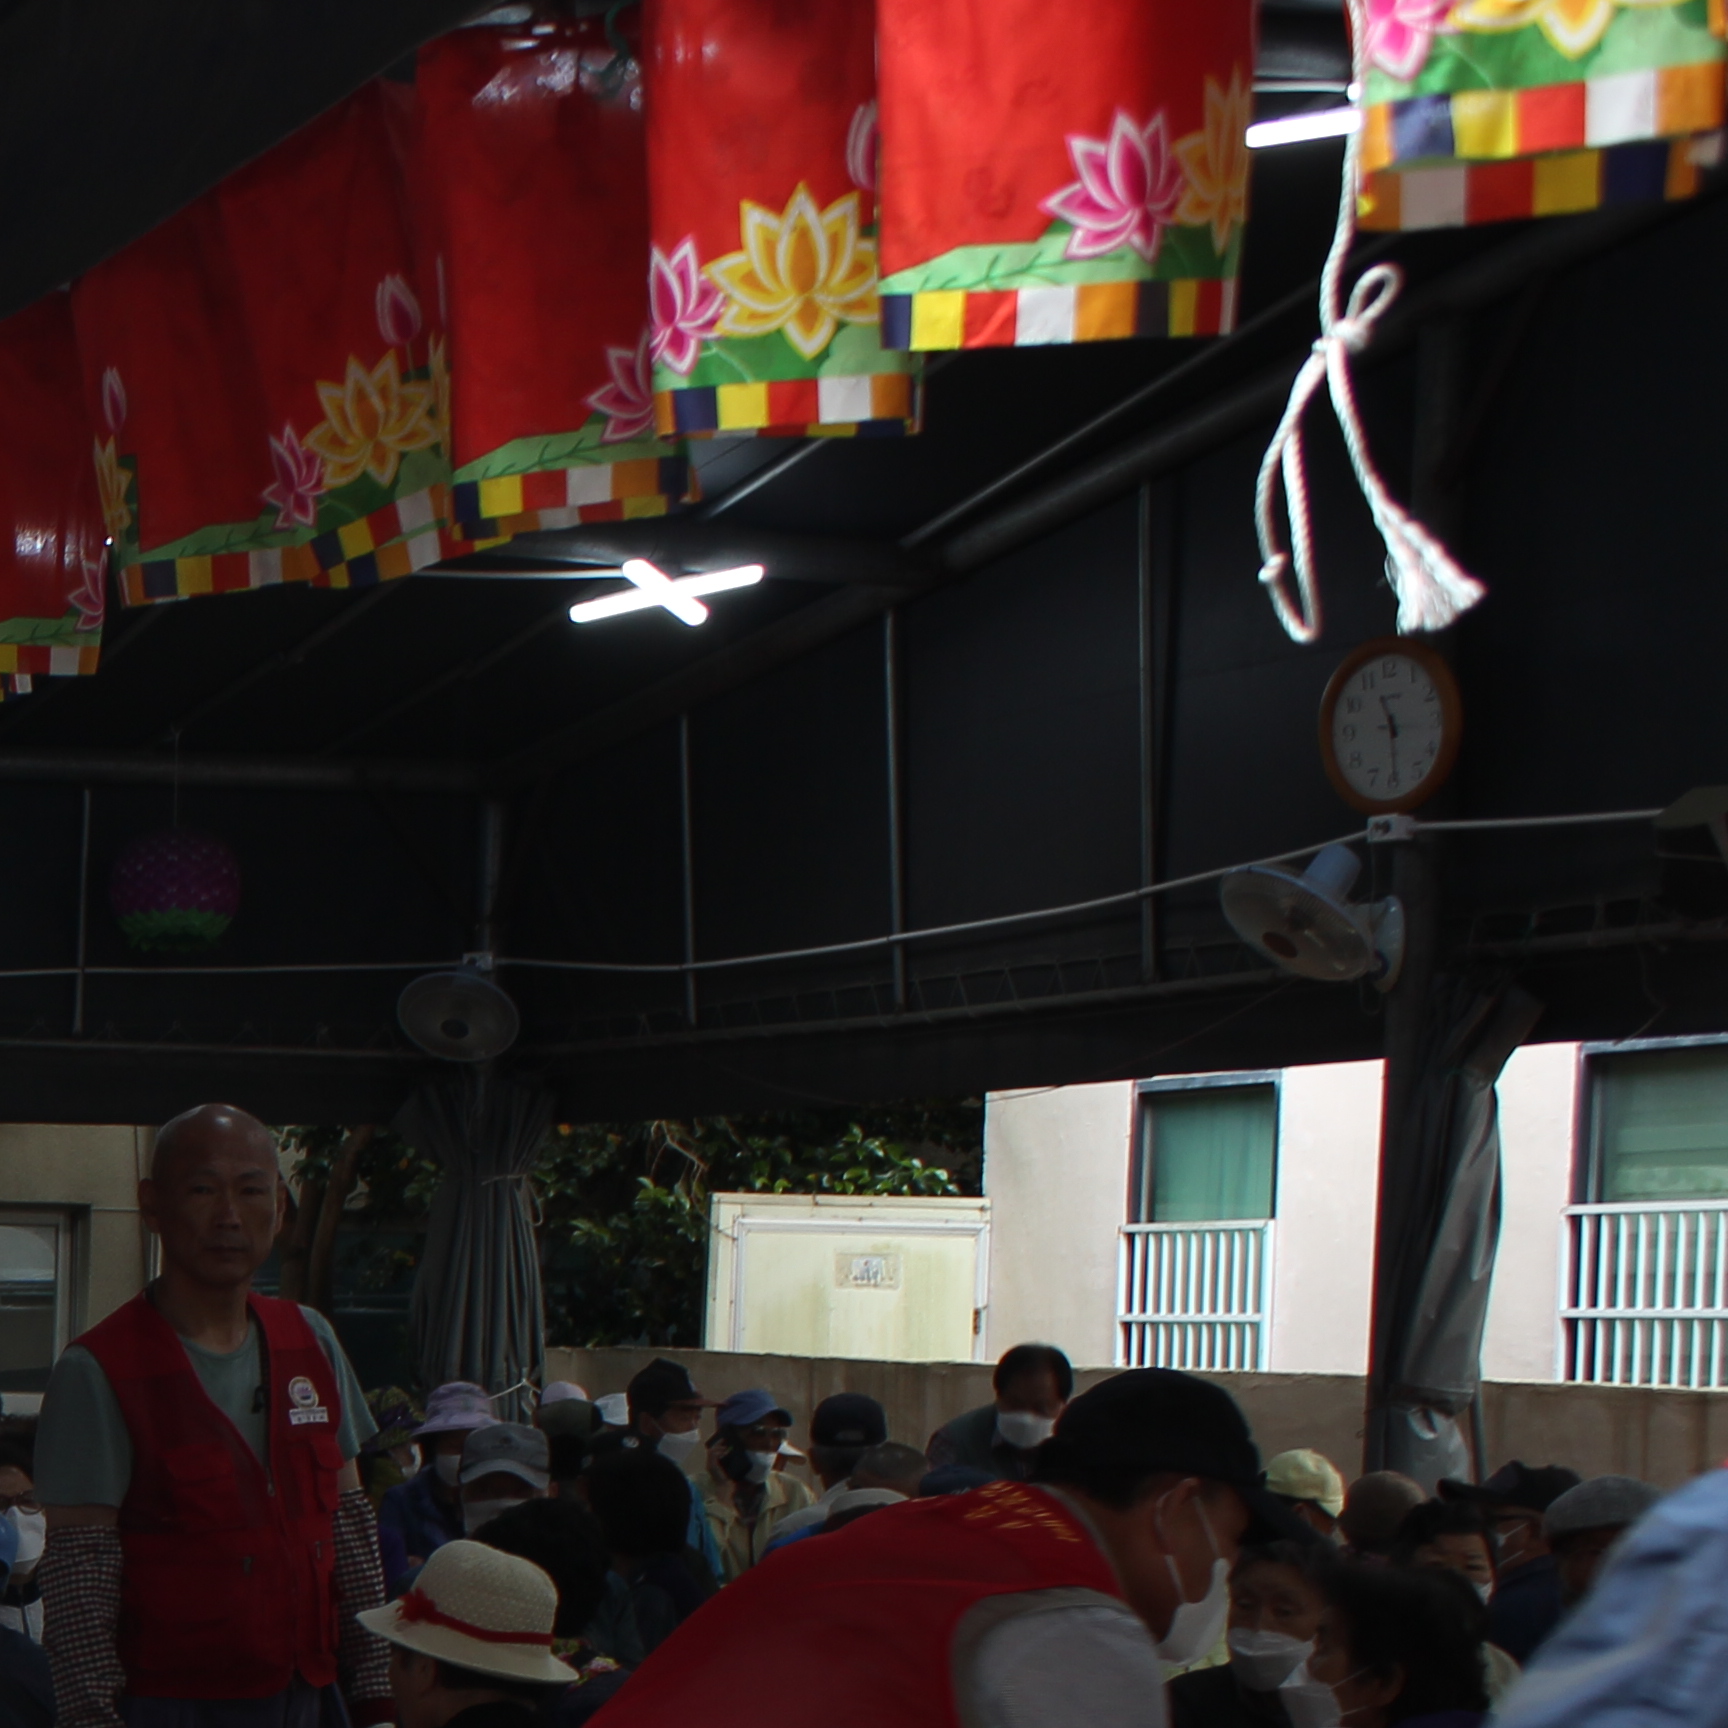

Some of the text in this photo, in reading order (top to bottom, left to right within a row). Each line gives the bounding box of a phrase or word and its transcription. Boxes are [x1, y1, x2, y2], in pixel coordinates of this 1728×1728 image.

[1382, 660, 1397, 679] 12
[1362, 671, 1375, 691] 11
[1347, 697, 1361, 715] 10
[1343, 725, 1356, 742] 9
[1349, 752, 1362, 769] 8
[1367, 768, 1380, 787] 7
